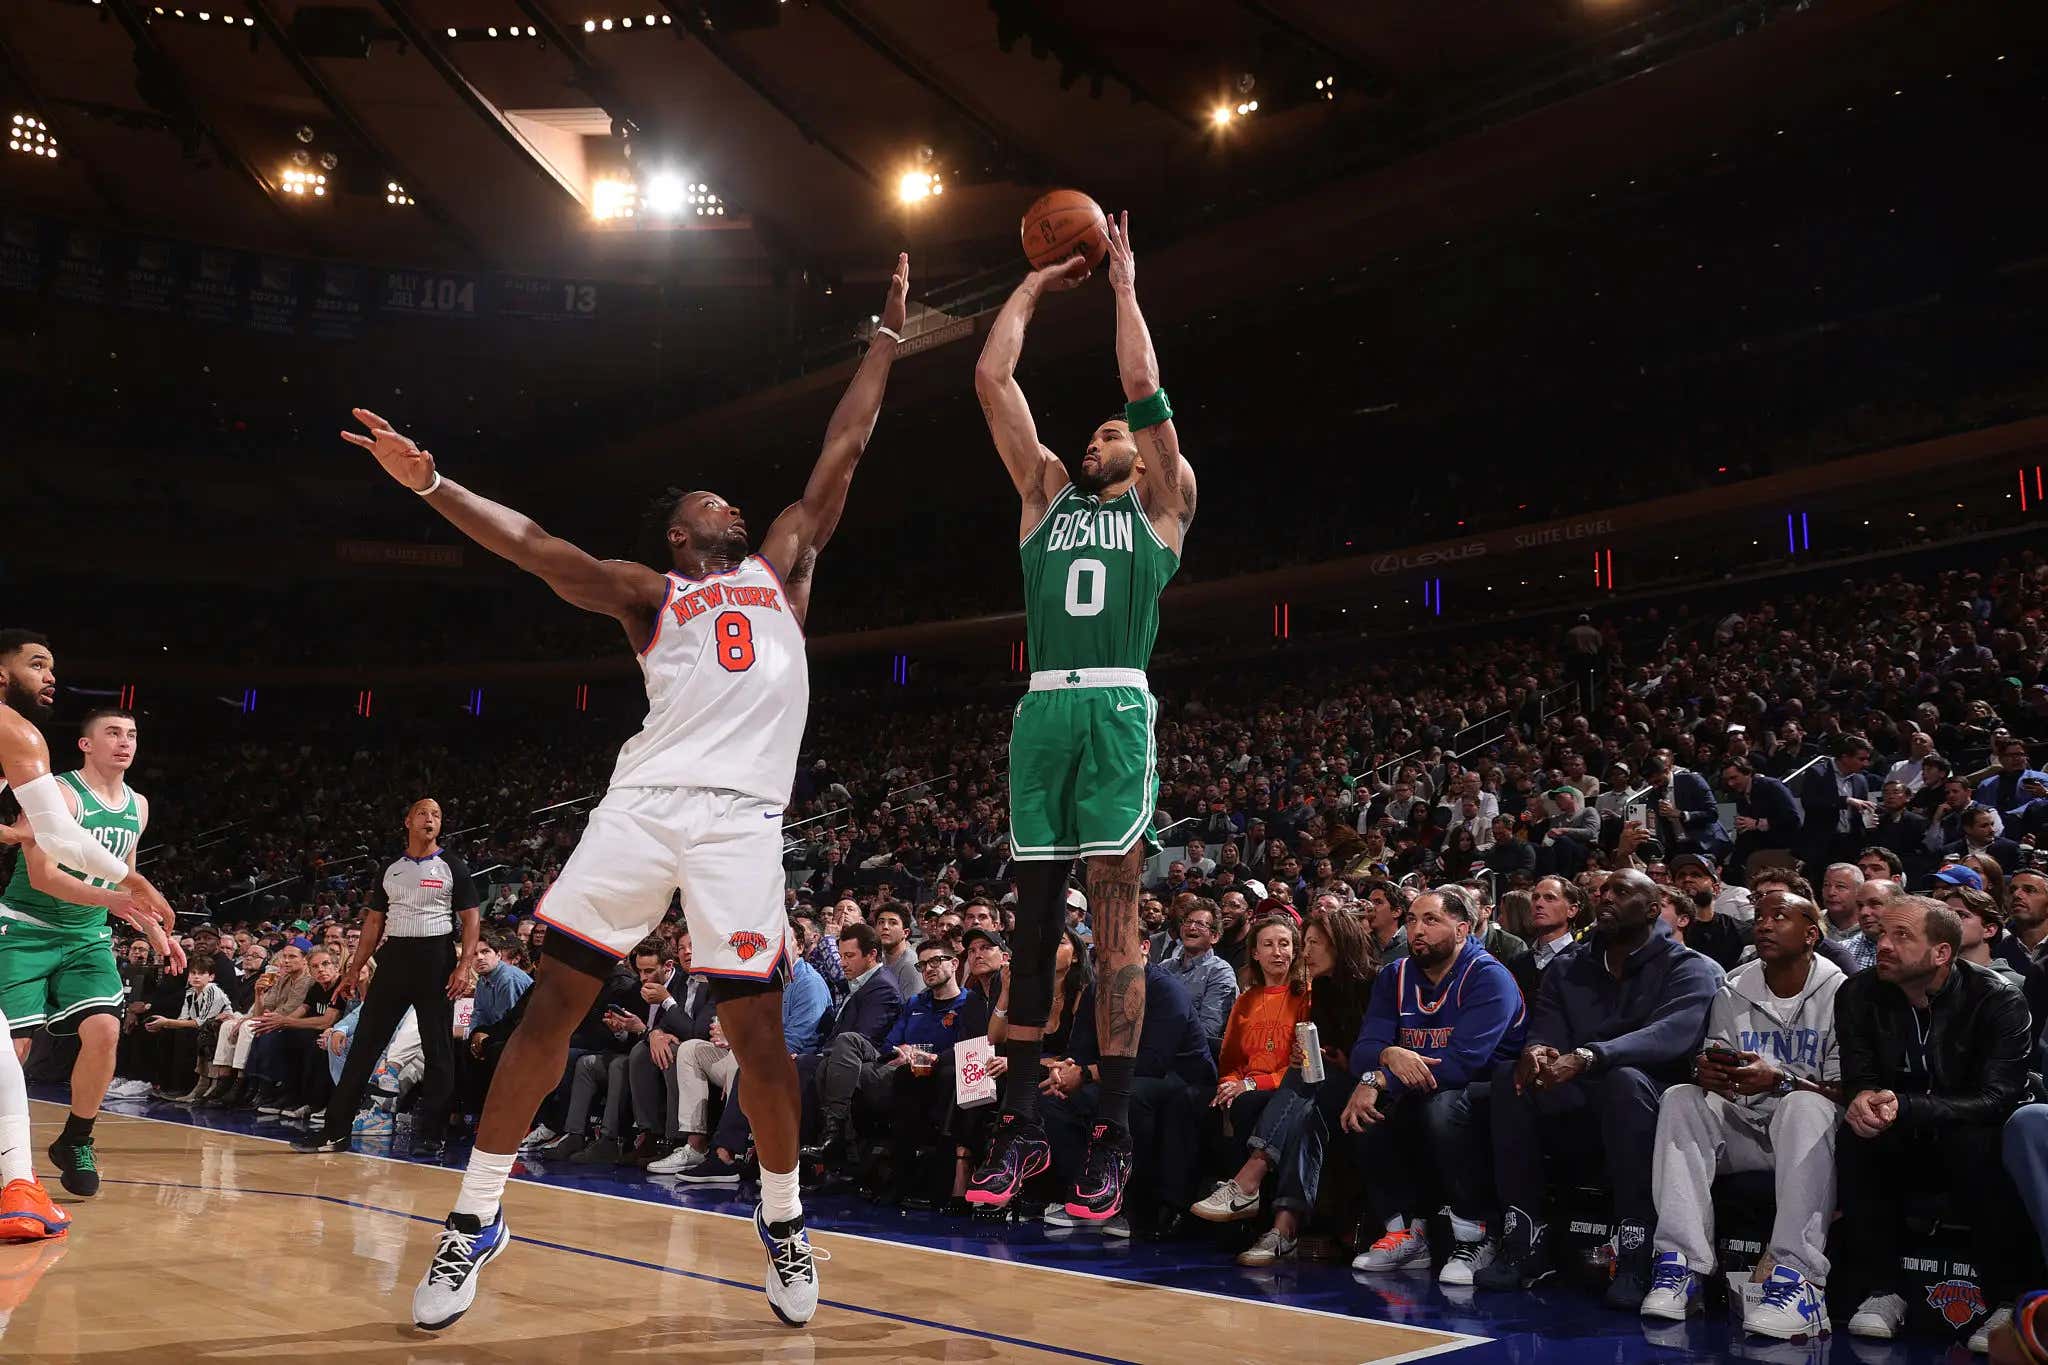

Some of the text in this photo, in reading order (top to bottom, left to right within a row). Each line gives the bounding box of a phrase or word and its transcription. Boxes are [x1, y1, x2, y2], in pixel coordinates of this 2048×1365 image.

[420, 279, 475, 312] 104
[562, 284, 597, 312] 13
[1047, 509, 1134, 553] BOSTON
[1513, 518, 1617, 551] SUITE LEVEL
[1401, 542, 1489, 570] LEXUS
[1064, 558, 1107, 617] 0
[670, 582, 783, 627] NEW YORK
[715, 611, 756, 672] 8
[728, 931, 767, 950] KNICKS
[961, 1063, 978, 1076] POP
[964, 1067, 985, 1084] CORN
[1569, 1220, 1592, 1234] SECTION
[1953, 1262, 1970, 1277] ROW
